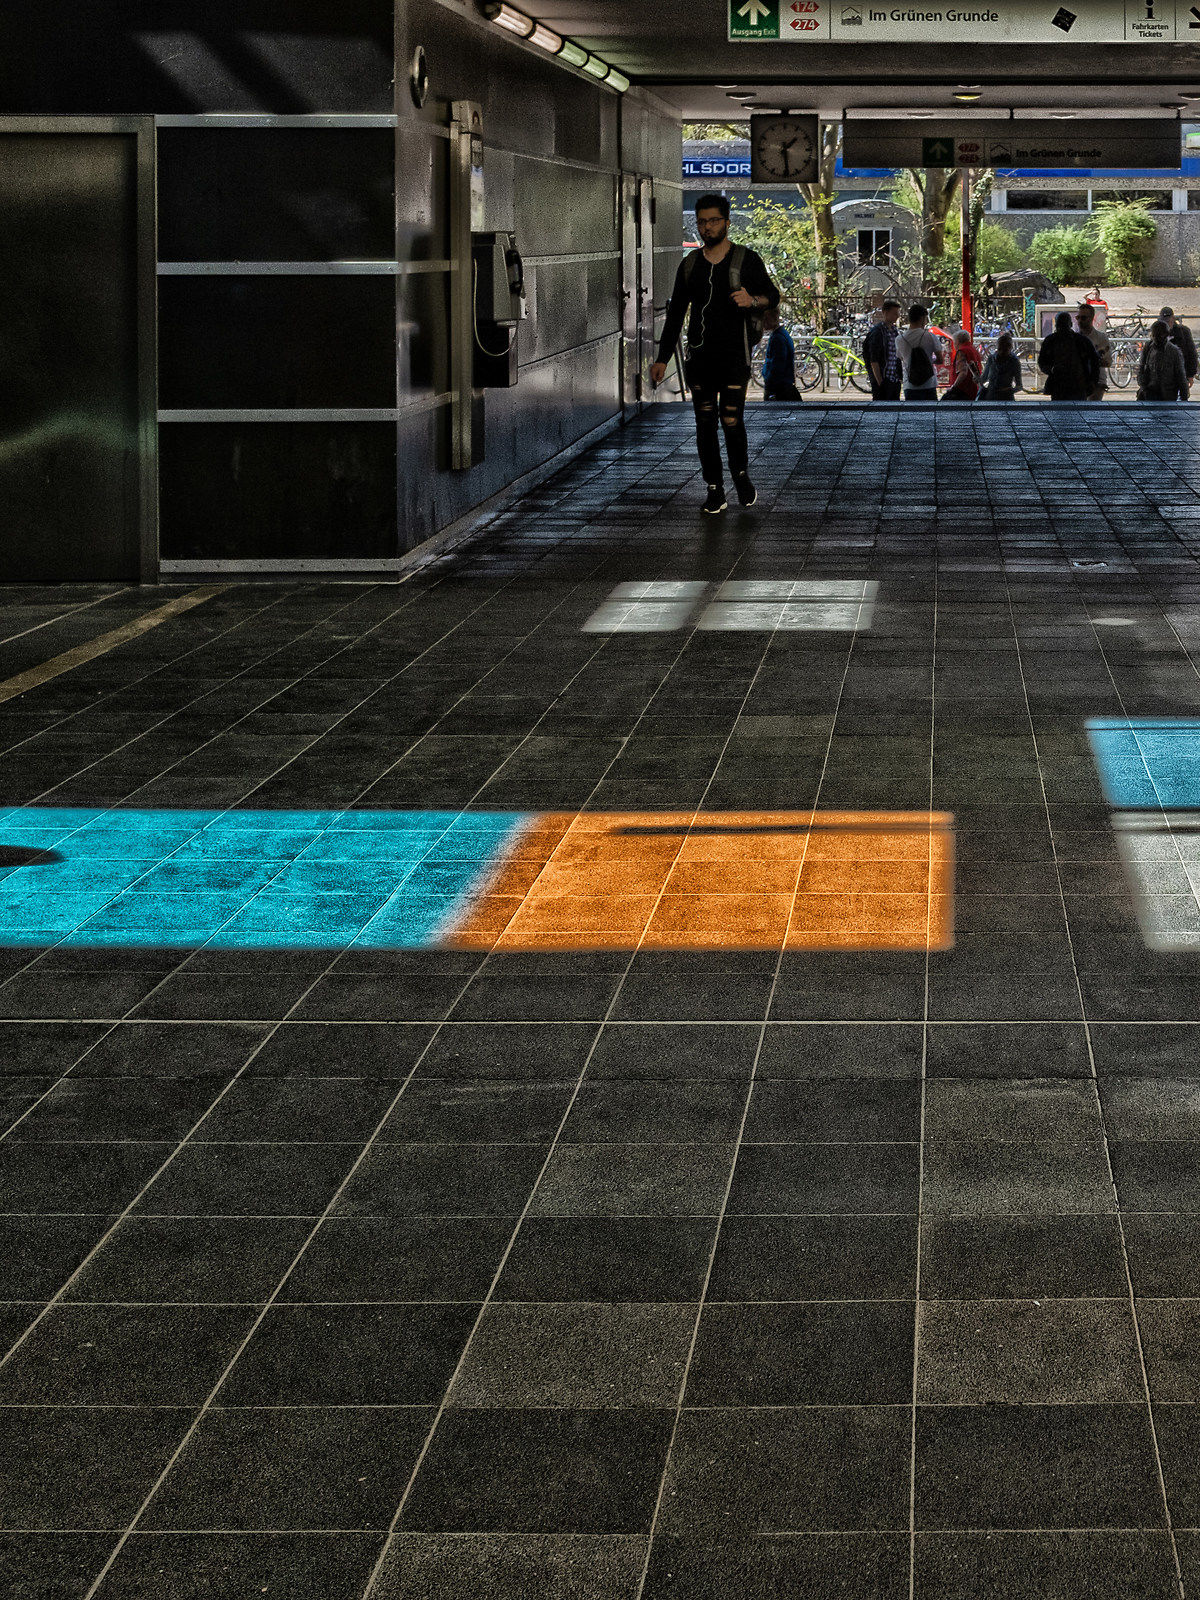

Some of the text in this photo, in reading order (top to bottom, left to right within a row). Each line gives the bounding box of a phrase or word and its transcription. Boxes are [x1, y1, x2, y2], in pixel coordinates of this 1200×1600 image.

[869, 8, 999, 22] Im Grünen Grunde
[795, 19, 815, 30] 274
[1132, 23, 1169, 31] Fahrkarten
[732, 28, 777, 37] Ausgang Exit
[1016, 149, 1102, 158] Im Grünen Grunde
